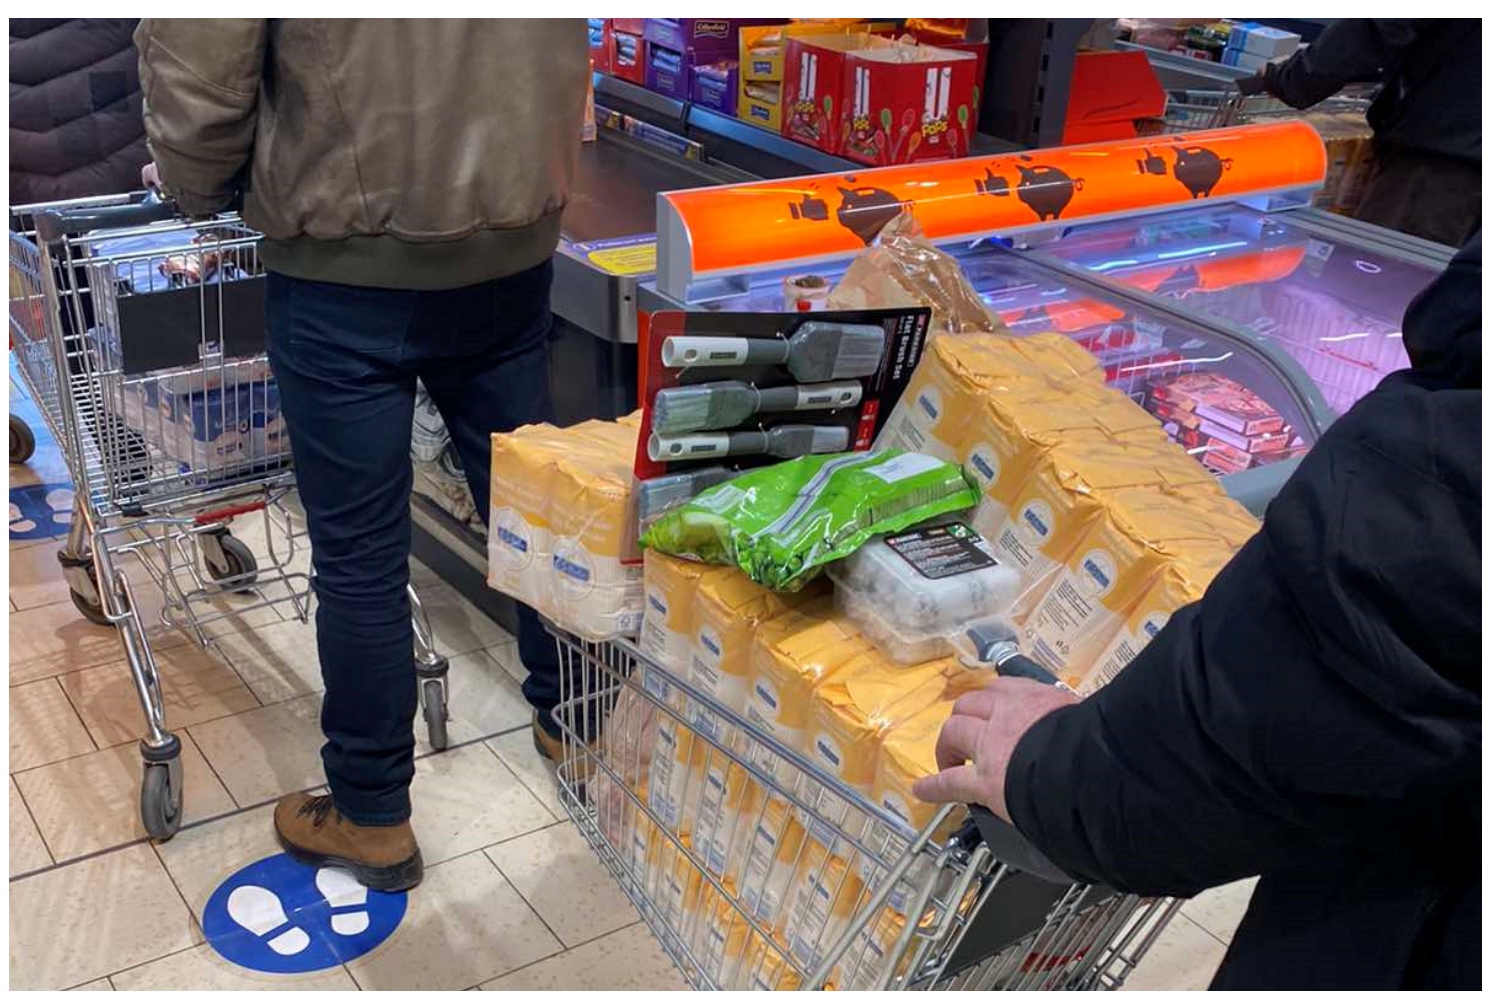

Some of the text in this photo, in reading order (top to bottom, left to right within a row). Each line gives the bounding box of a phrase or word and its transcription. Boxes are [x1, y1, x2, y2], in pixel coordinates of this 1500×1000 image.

[903, 314, 915, 334] Flat
[896, 335, 909, 363] Brush
[892, 364, 903, 380] Set
